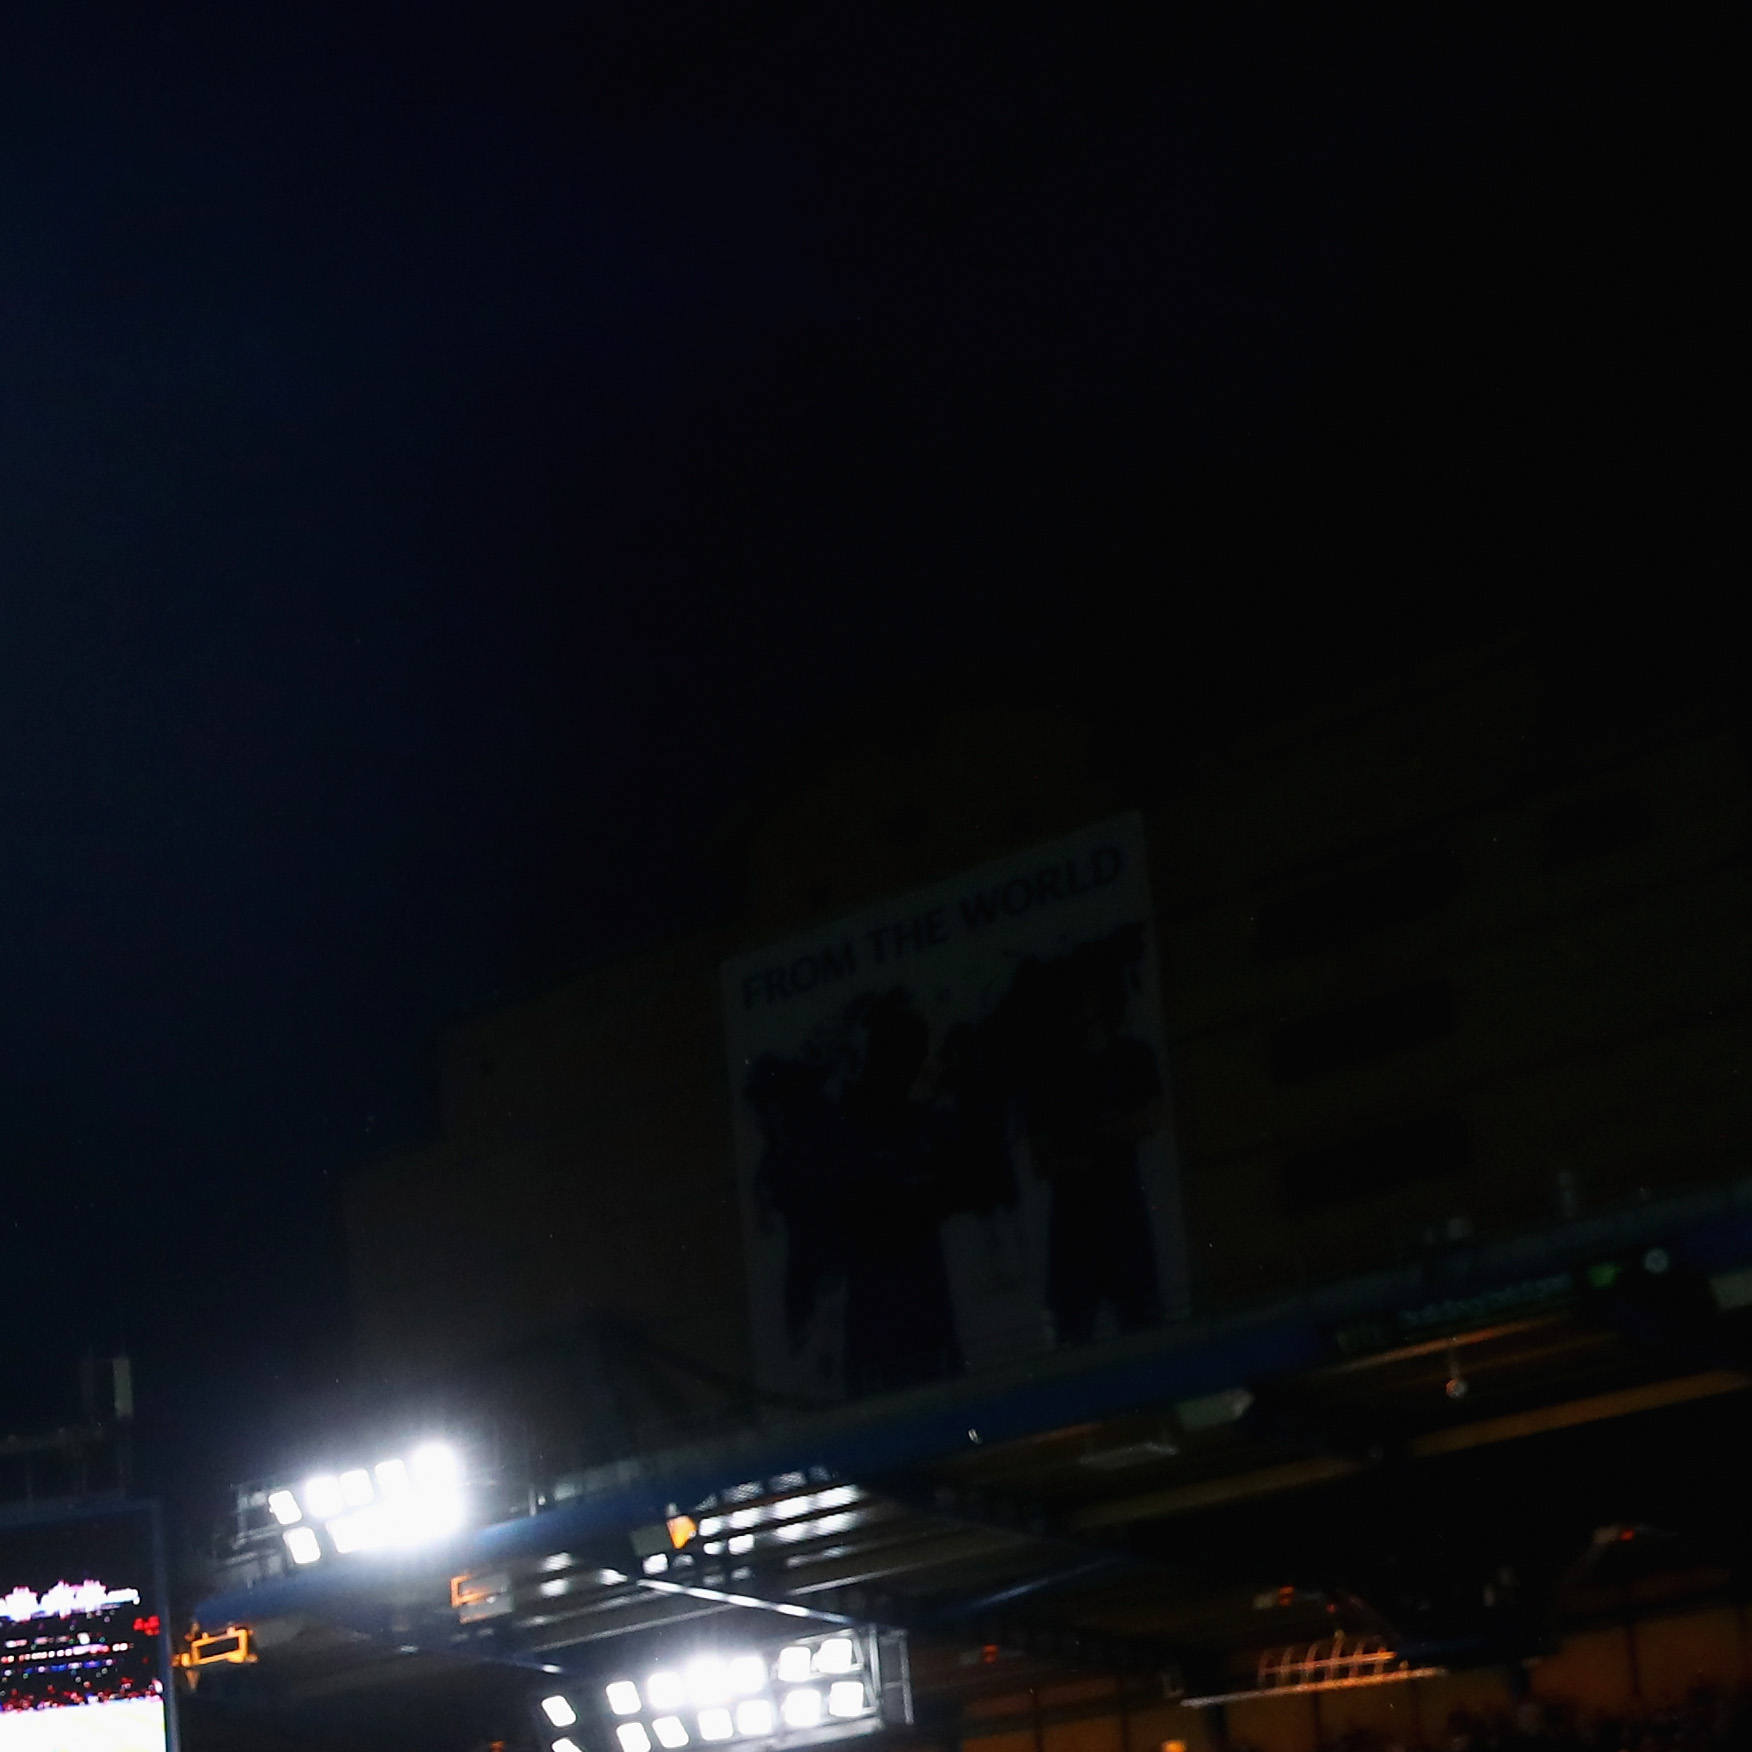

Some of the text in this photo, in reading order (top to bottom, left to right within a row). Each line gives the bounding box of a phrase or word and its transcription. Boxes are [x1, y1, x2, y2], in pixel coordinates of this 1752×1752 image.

[742, 845, 1123, 1010] FROM THE WORLD
